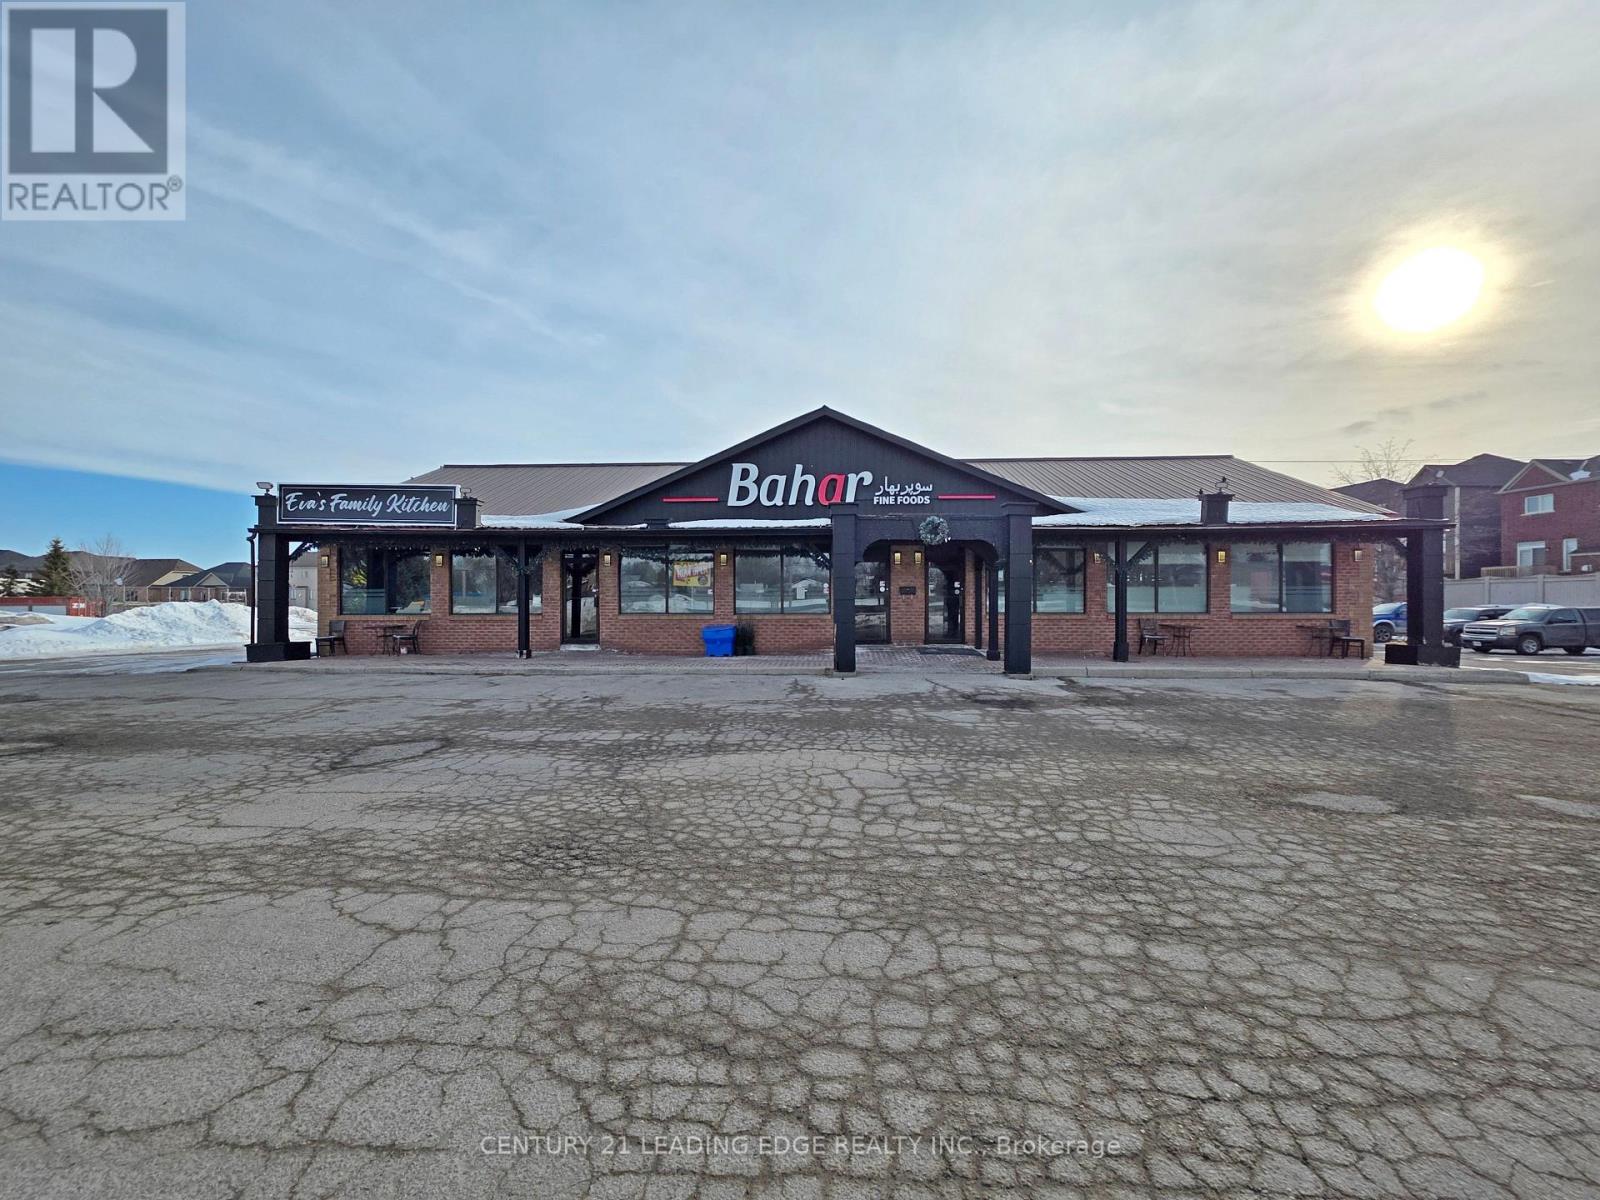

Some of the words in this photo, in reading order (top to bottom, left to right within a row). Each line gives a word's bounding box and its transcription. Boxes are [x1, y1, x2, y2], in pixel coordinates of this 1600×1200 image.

[727, 463, 873, 507] Bahar
[875, 475, 901, 496] بهار
[285, 491, 326, 512] Eva's
[331, 494, 383, 517] Family
[387, 493, 450, 513] Kitchen
[873, 495, 896, 505] FINE
[897, 495, 931, 505] FOODS
